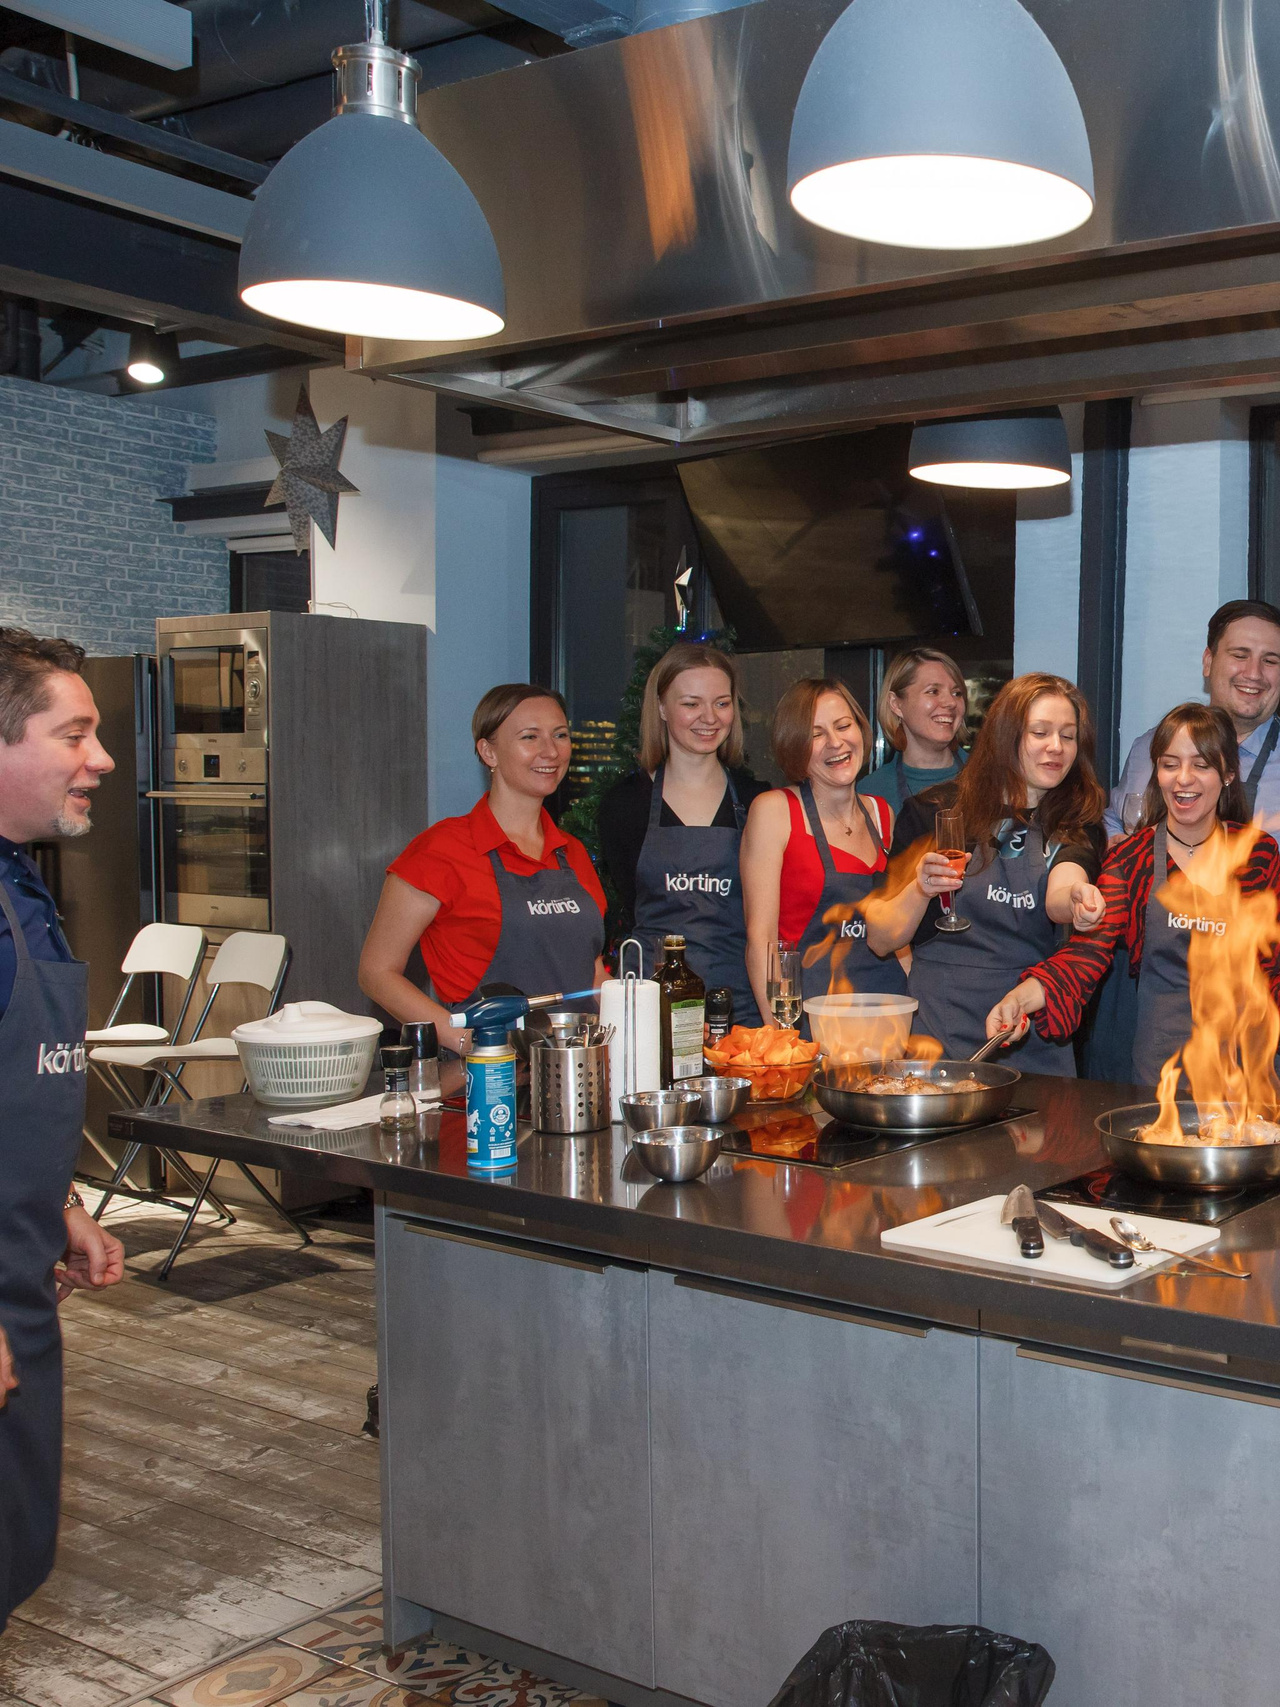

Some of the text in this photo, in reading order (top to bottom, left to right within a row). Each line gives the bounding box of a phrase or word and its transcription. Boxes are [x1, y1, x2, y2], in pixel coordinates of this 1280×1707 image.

[666, 873, 732, 896] körting
[526, 899, 580, 915] körting
[987, 884, 1036, 910] köring
[1168, 912, 1227, 937] körting
